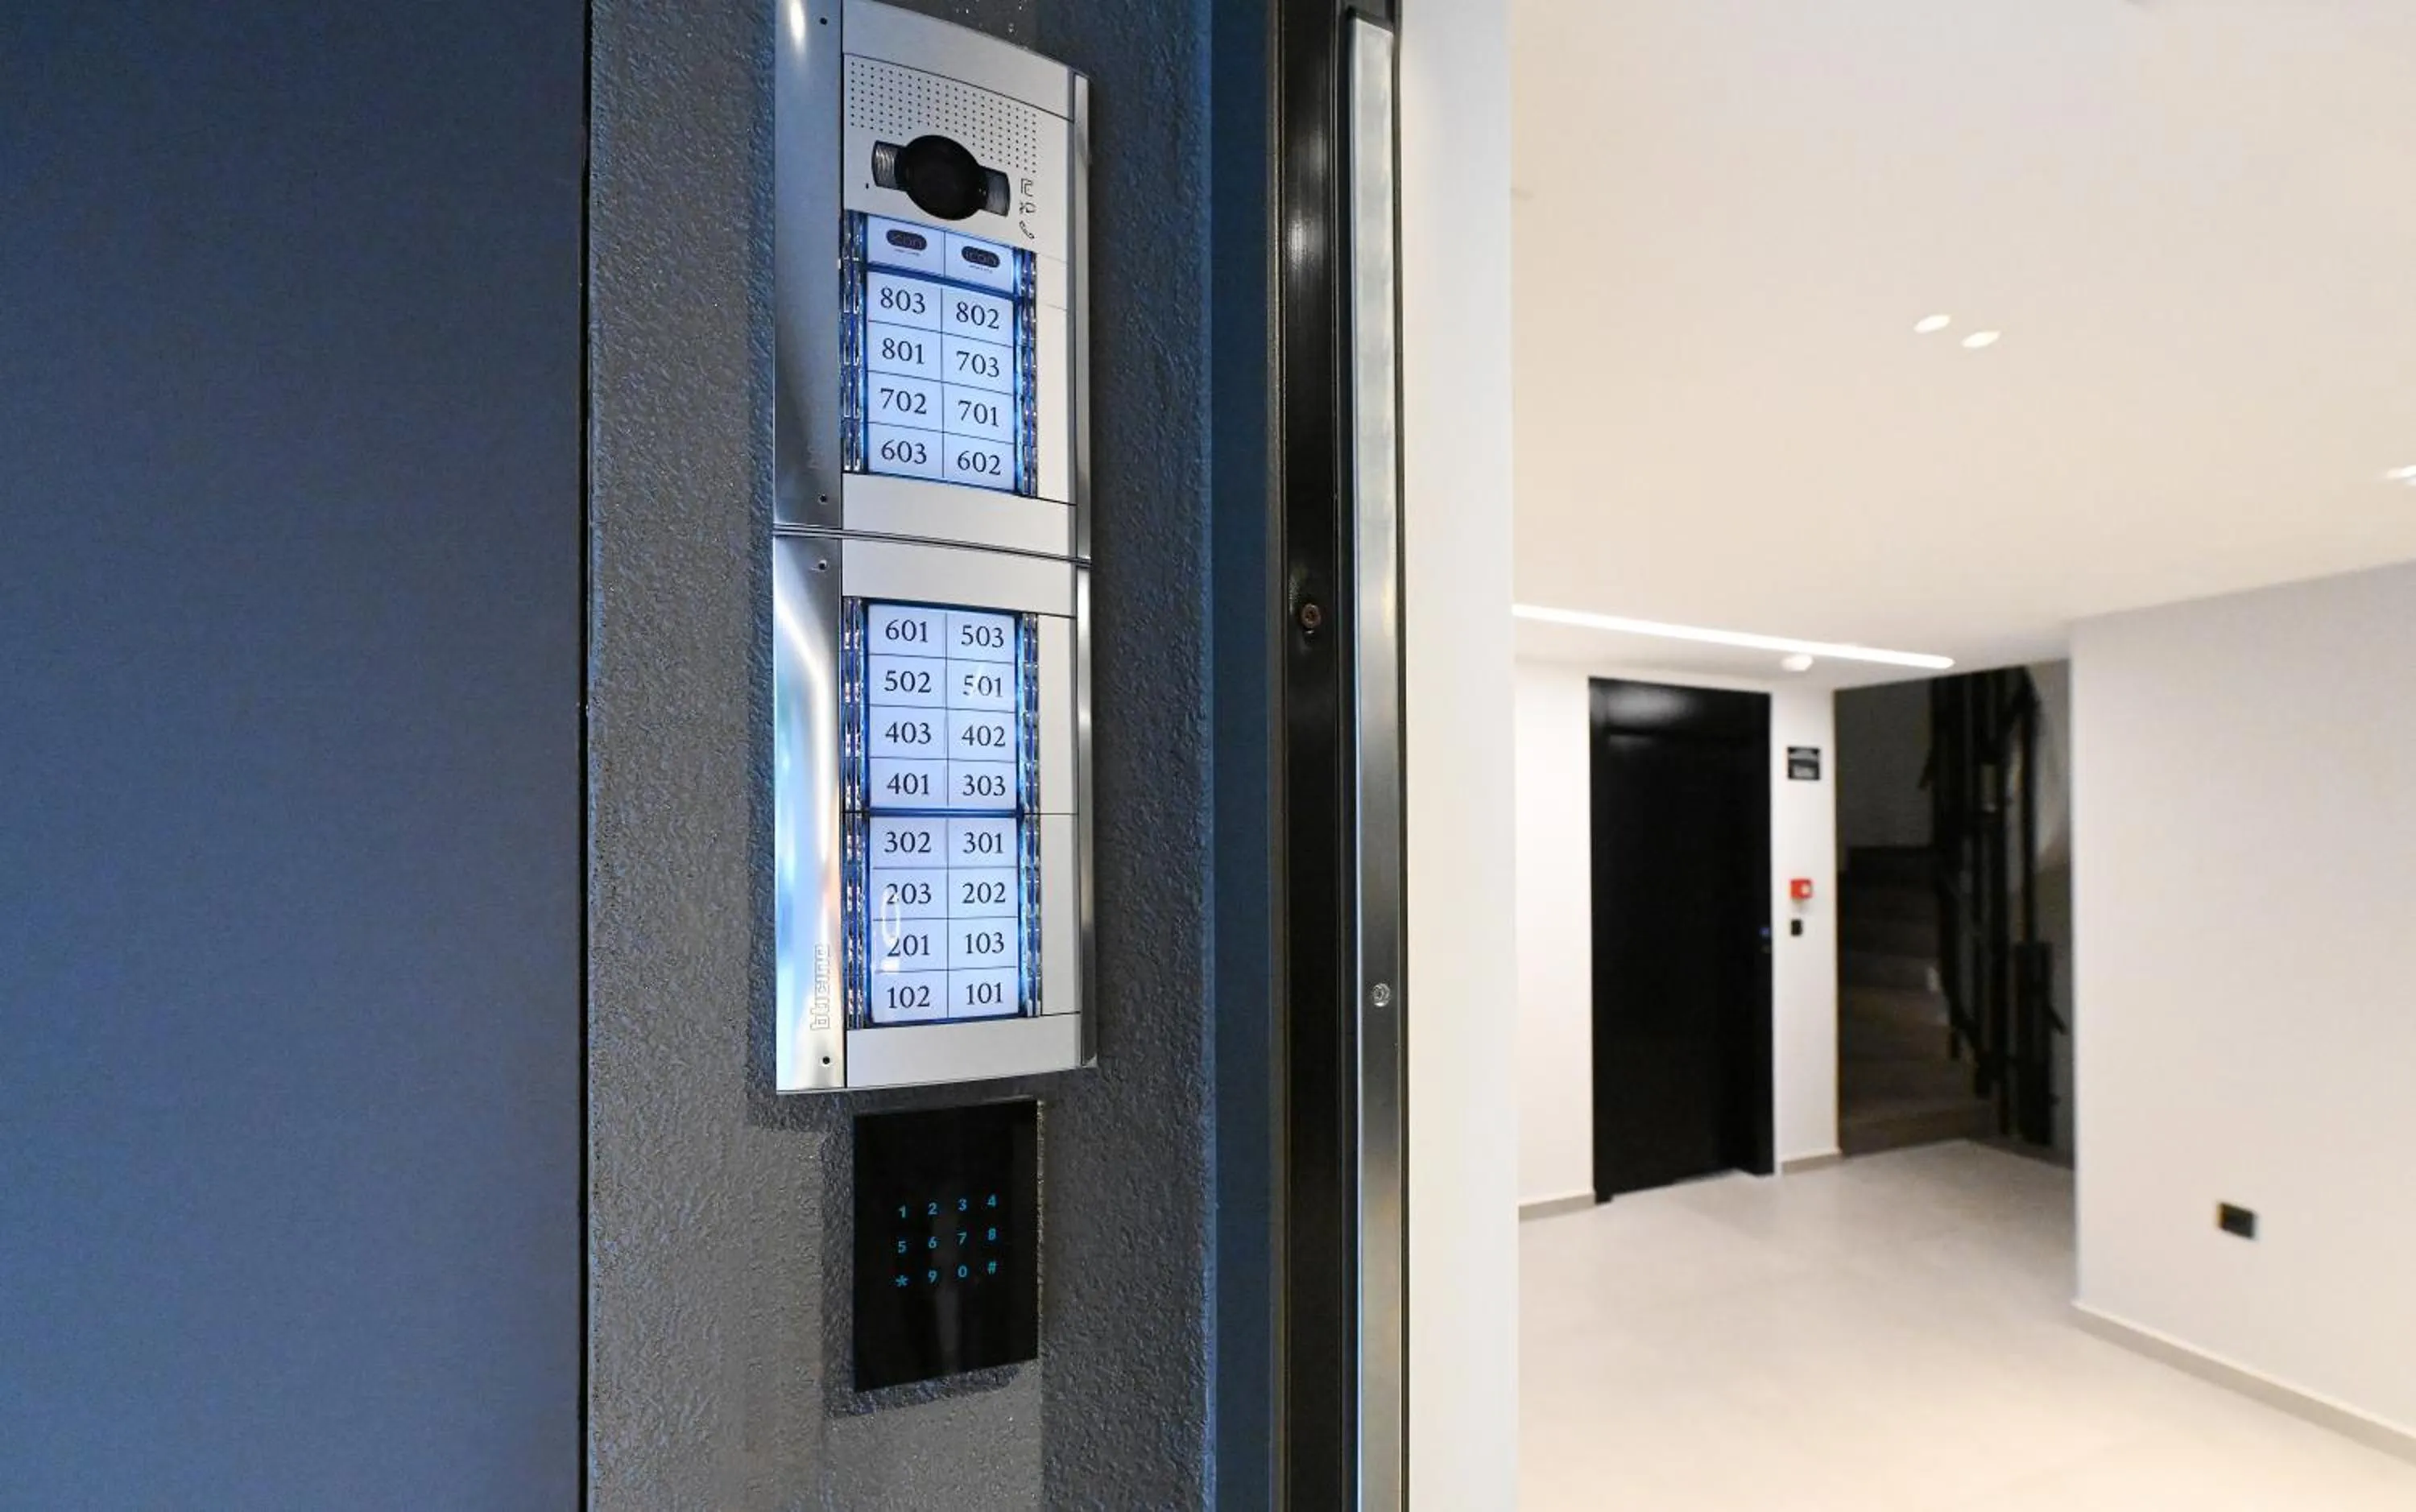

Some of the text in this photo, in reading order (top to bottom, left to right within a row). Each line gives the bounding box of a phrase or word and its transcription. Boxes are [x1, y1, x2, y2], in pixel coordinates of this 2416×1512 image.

[879, 285, 926, 315] 803
[955, 300, 999, 330] 802
[882, 337, 925, 365] 801
[956, 350, 999, 378] 703
[880, 387, 927, 415] 702
[958, 399, 999, 428] 701
[880, 439, 927, 465] 603
[957, 450, 1001, 476] 602
[885, 618, 929, 643] 601
[961, 624, 1004, 648] 503
[883, 669, 932, 693] 502
[962, 674, 1001, 697] 501
[884, 721, 932, 745] 403
[961, 725, 1006, 748] 402
[886, 772, 929, 795] 401
[962, 774, 1006, 796] 303
[883, 830, 932, 853] 302
[962, 831, 1003, 854] 301
[886, 882, 932, 906] 203
[962, 882, 1006, 904] 202
[887, 934, 930, 957] 201
[966, 932, 1004, 955] 103
[887, 985, 930, 1009] 102
[966, 981, 1003, 1006] 101
[898, 1194, 996, 1218] 1 2 3 4
[898, 1228, 996, 1253] 5 6 7 8
[929, 1270, 937, 1284] 9
[958, 1266, 966, 1278] 0
